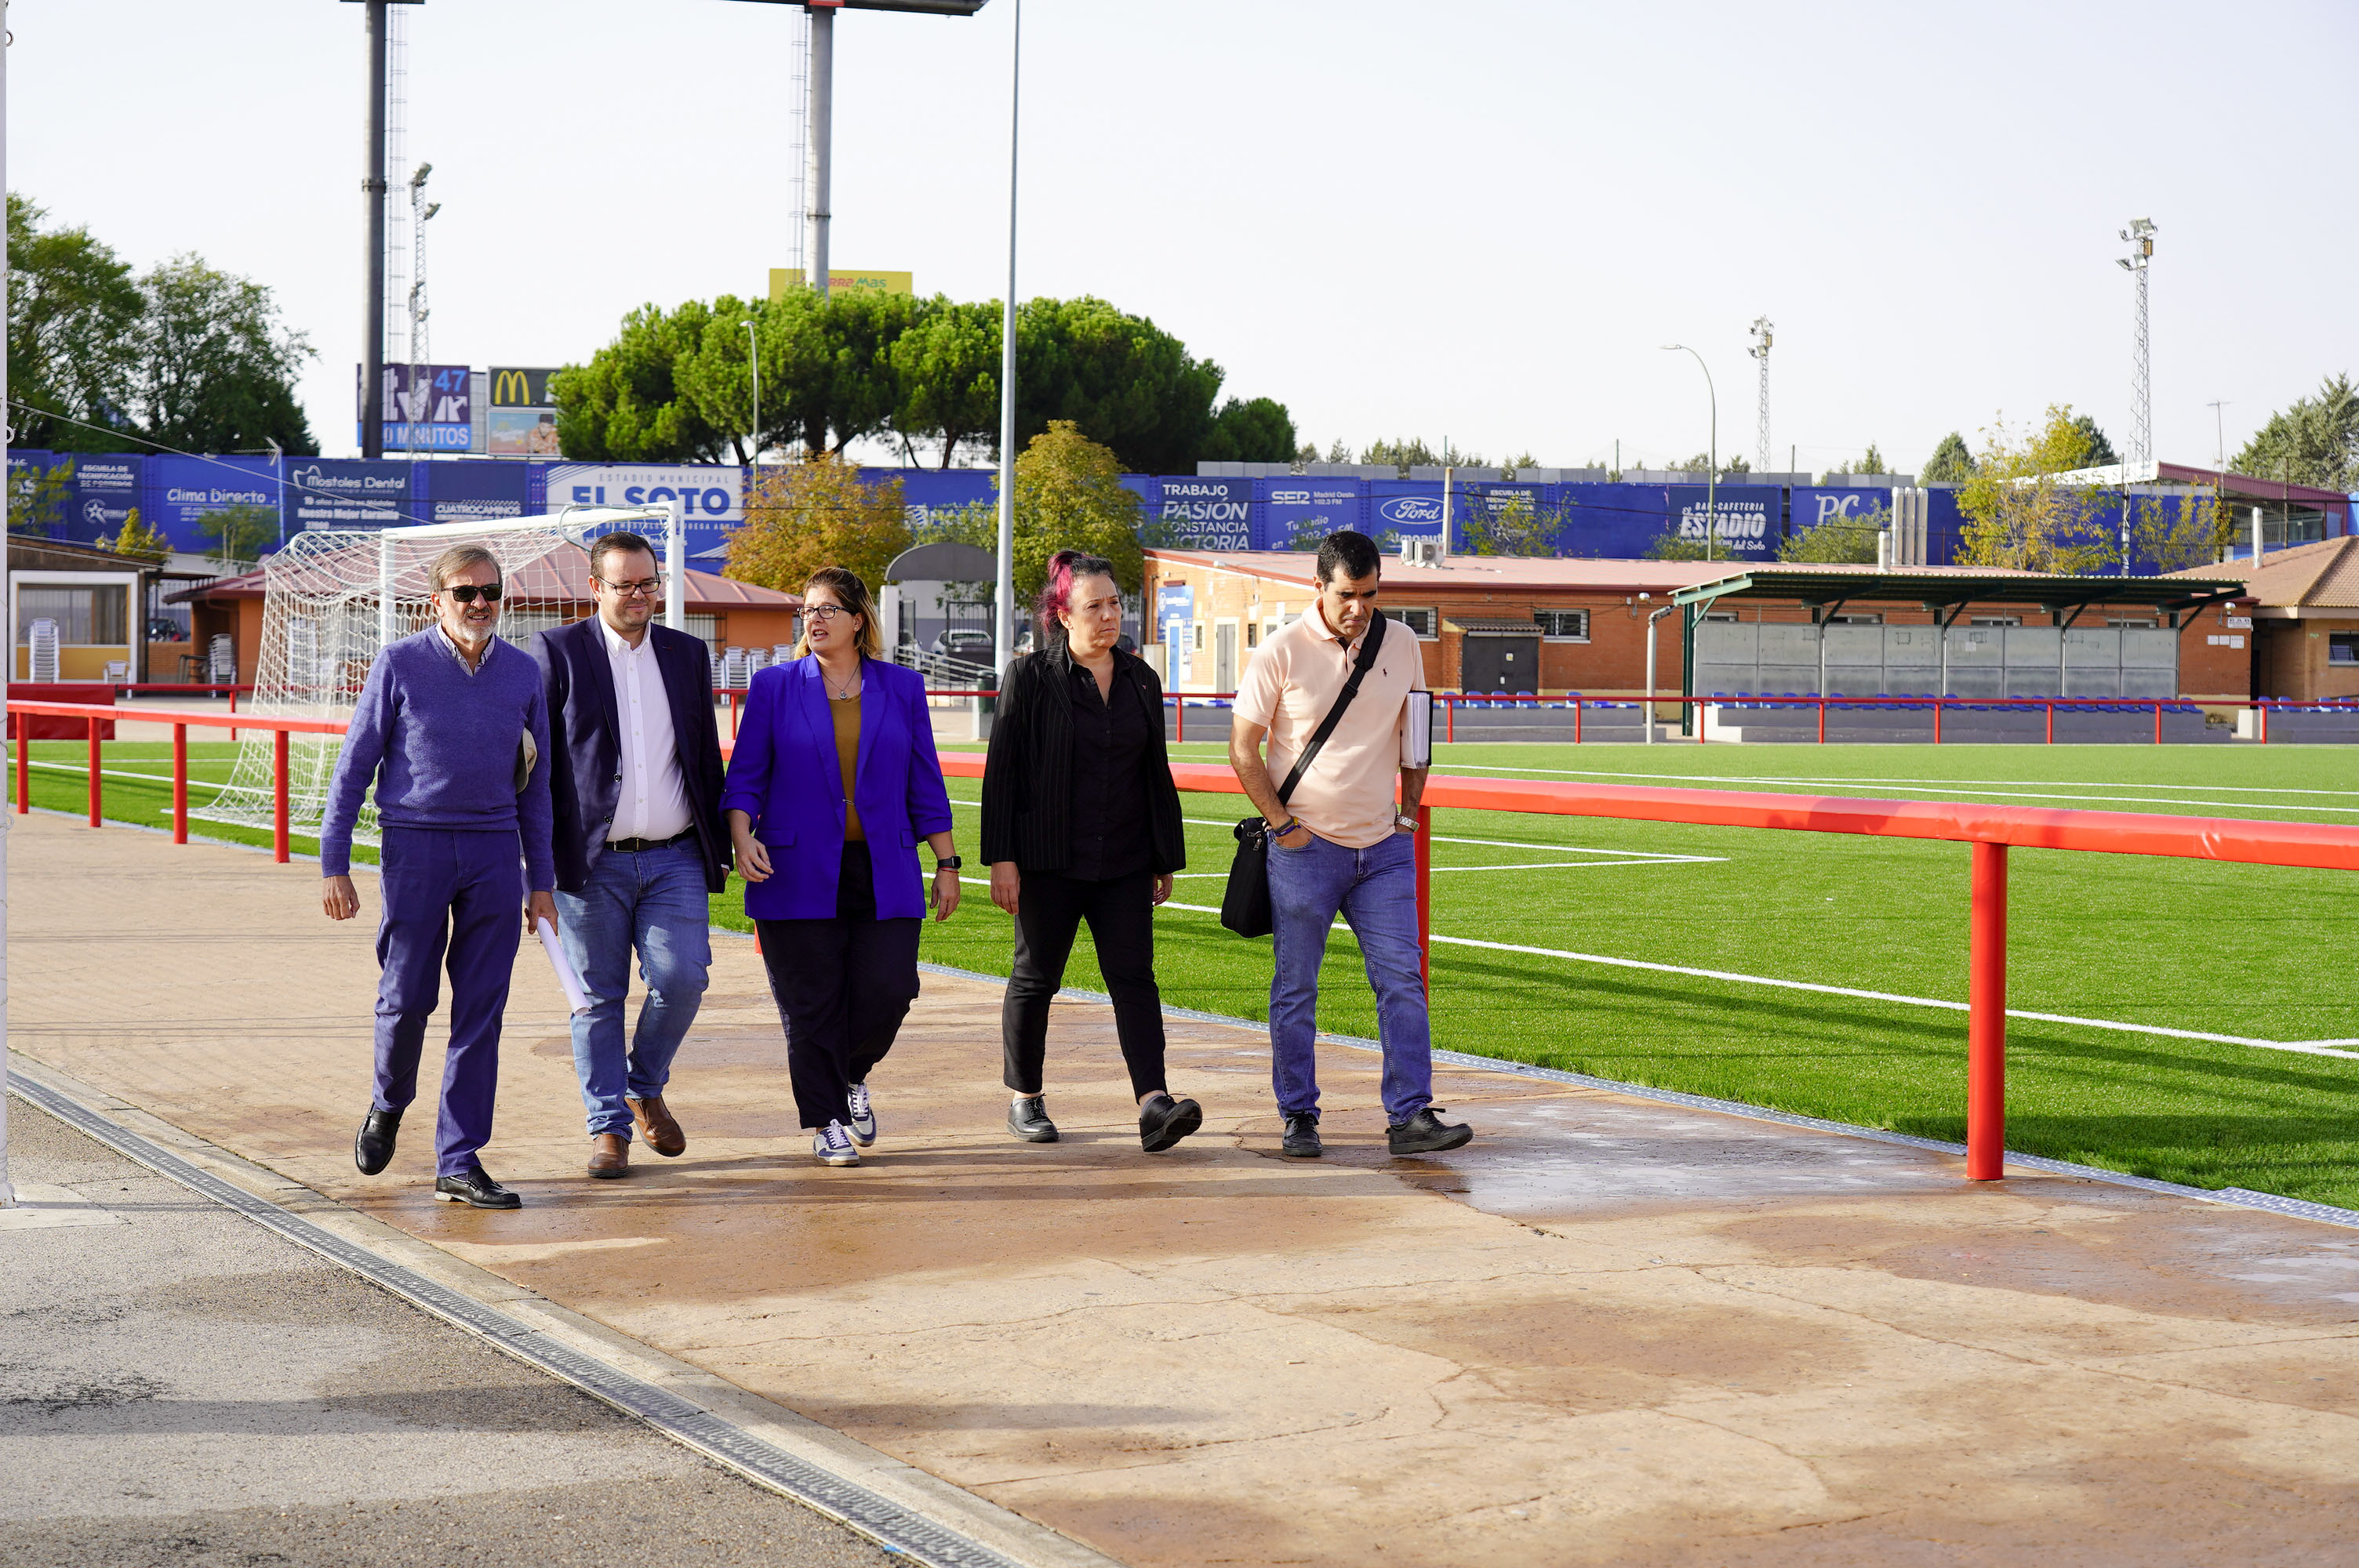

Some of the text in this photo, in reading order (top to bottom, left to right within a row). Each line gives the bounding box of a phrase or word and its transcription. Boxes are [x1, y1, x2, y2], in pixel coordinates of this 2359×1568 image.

[434, 369, 467, 392] 47
[398, 426, 468, 445] MNUTOS
[364, 476, 405, 489] Dental
[599, 473, 729, 485] ESTADIO MUNICIPAL
[166, 487, 267, 504] Clima Directo
[1162, 484, 1229, 496] TRABAJO
[1271, 491, 1310, 505] SER
[624, 486, 731, 516] SOTO
[1162, 496, 1249, 521] PASIÓN
[434, 504, 522, 516] CUATROCAMINOS
[1395, 499, 1441, 521] Ford
[684, 522, 710, 531] UEGA
[1680, 512, 1767, 539] ESTADIO
